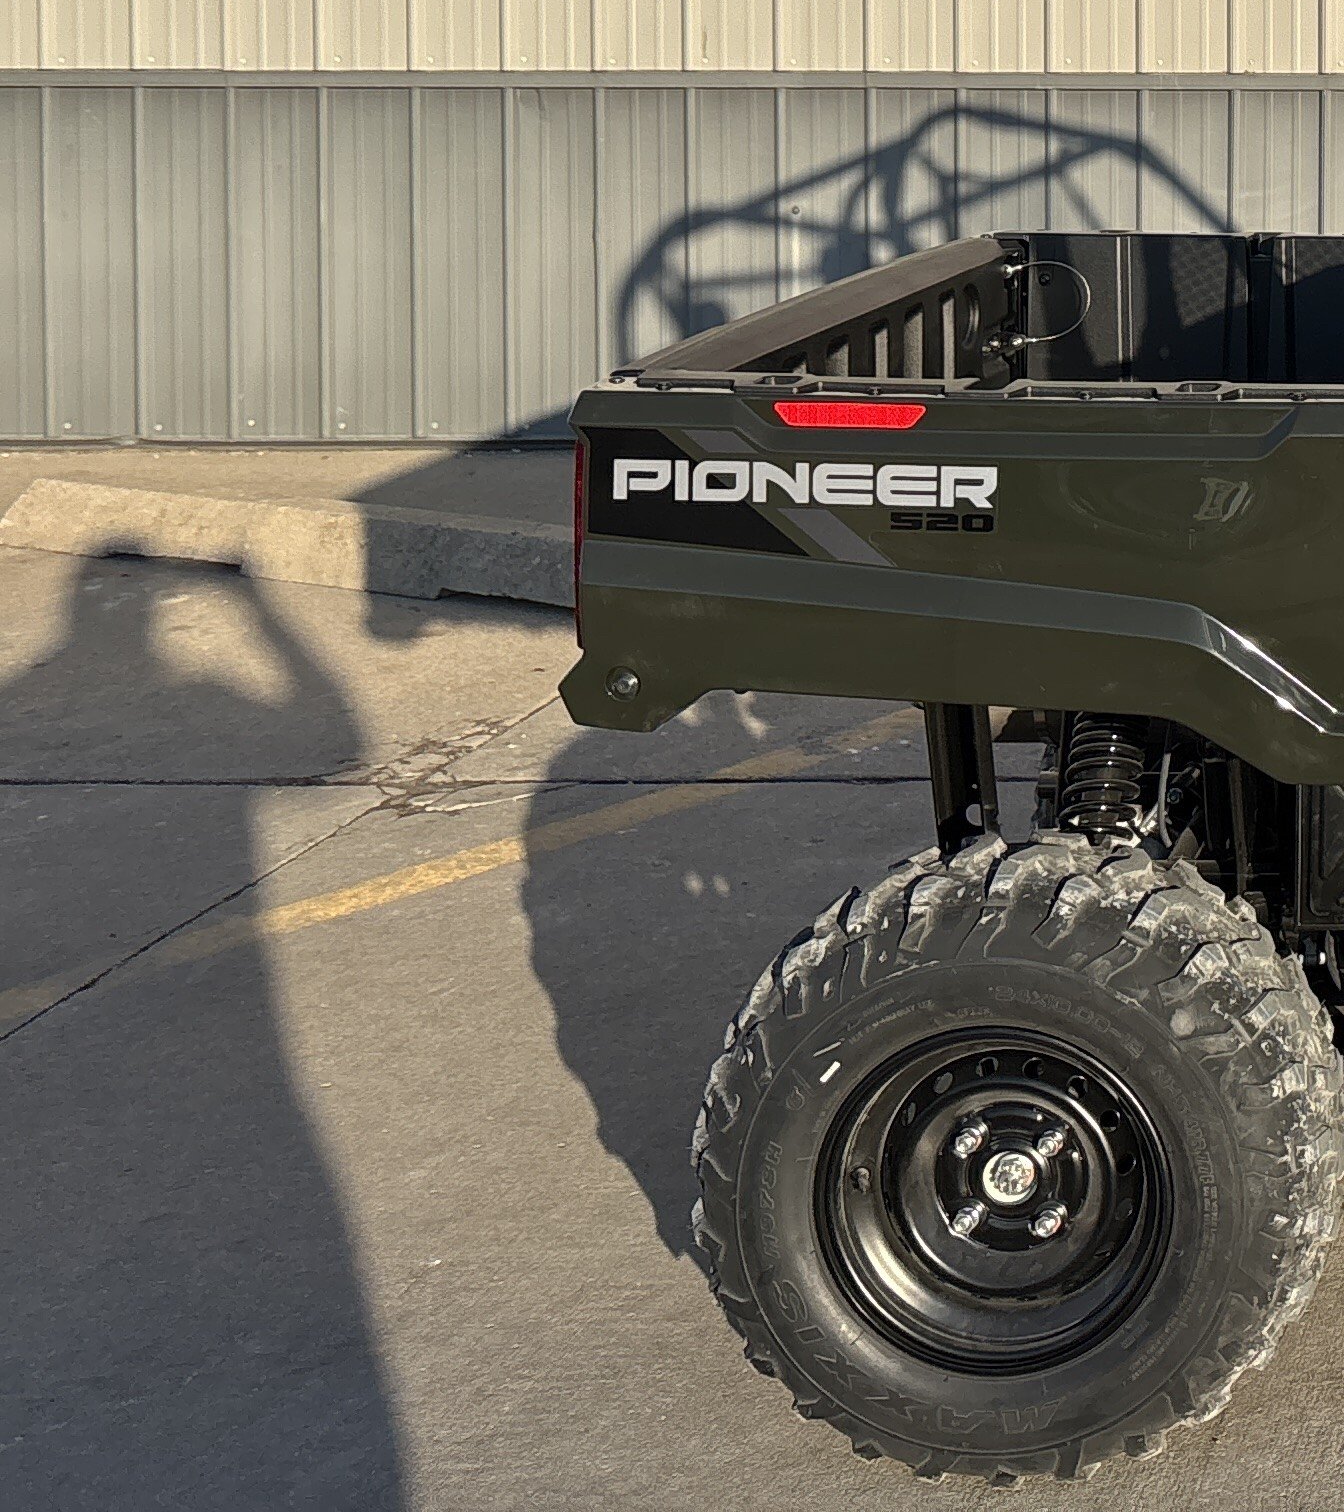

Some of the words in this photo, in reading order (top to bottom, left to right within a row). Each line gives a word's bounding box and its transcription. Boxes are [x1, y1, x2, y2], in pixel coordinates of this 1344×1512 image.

[612, 458, 999, 509] PIONEER
[890, 511, 994, 533] 520
[772, 1279, 1068, 1434] MAXXIS
